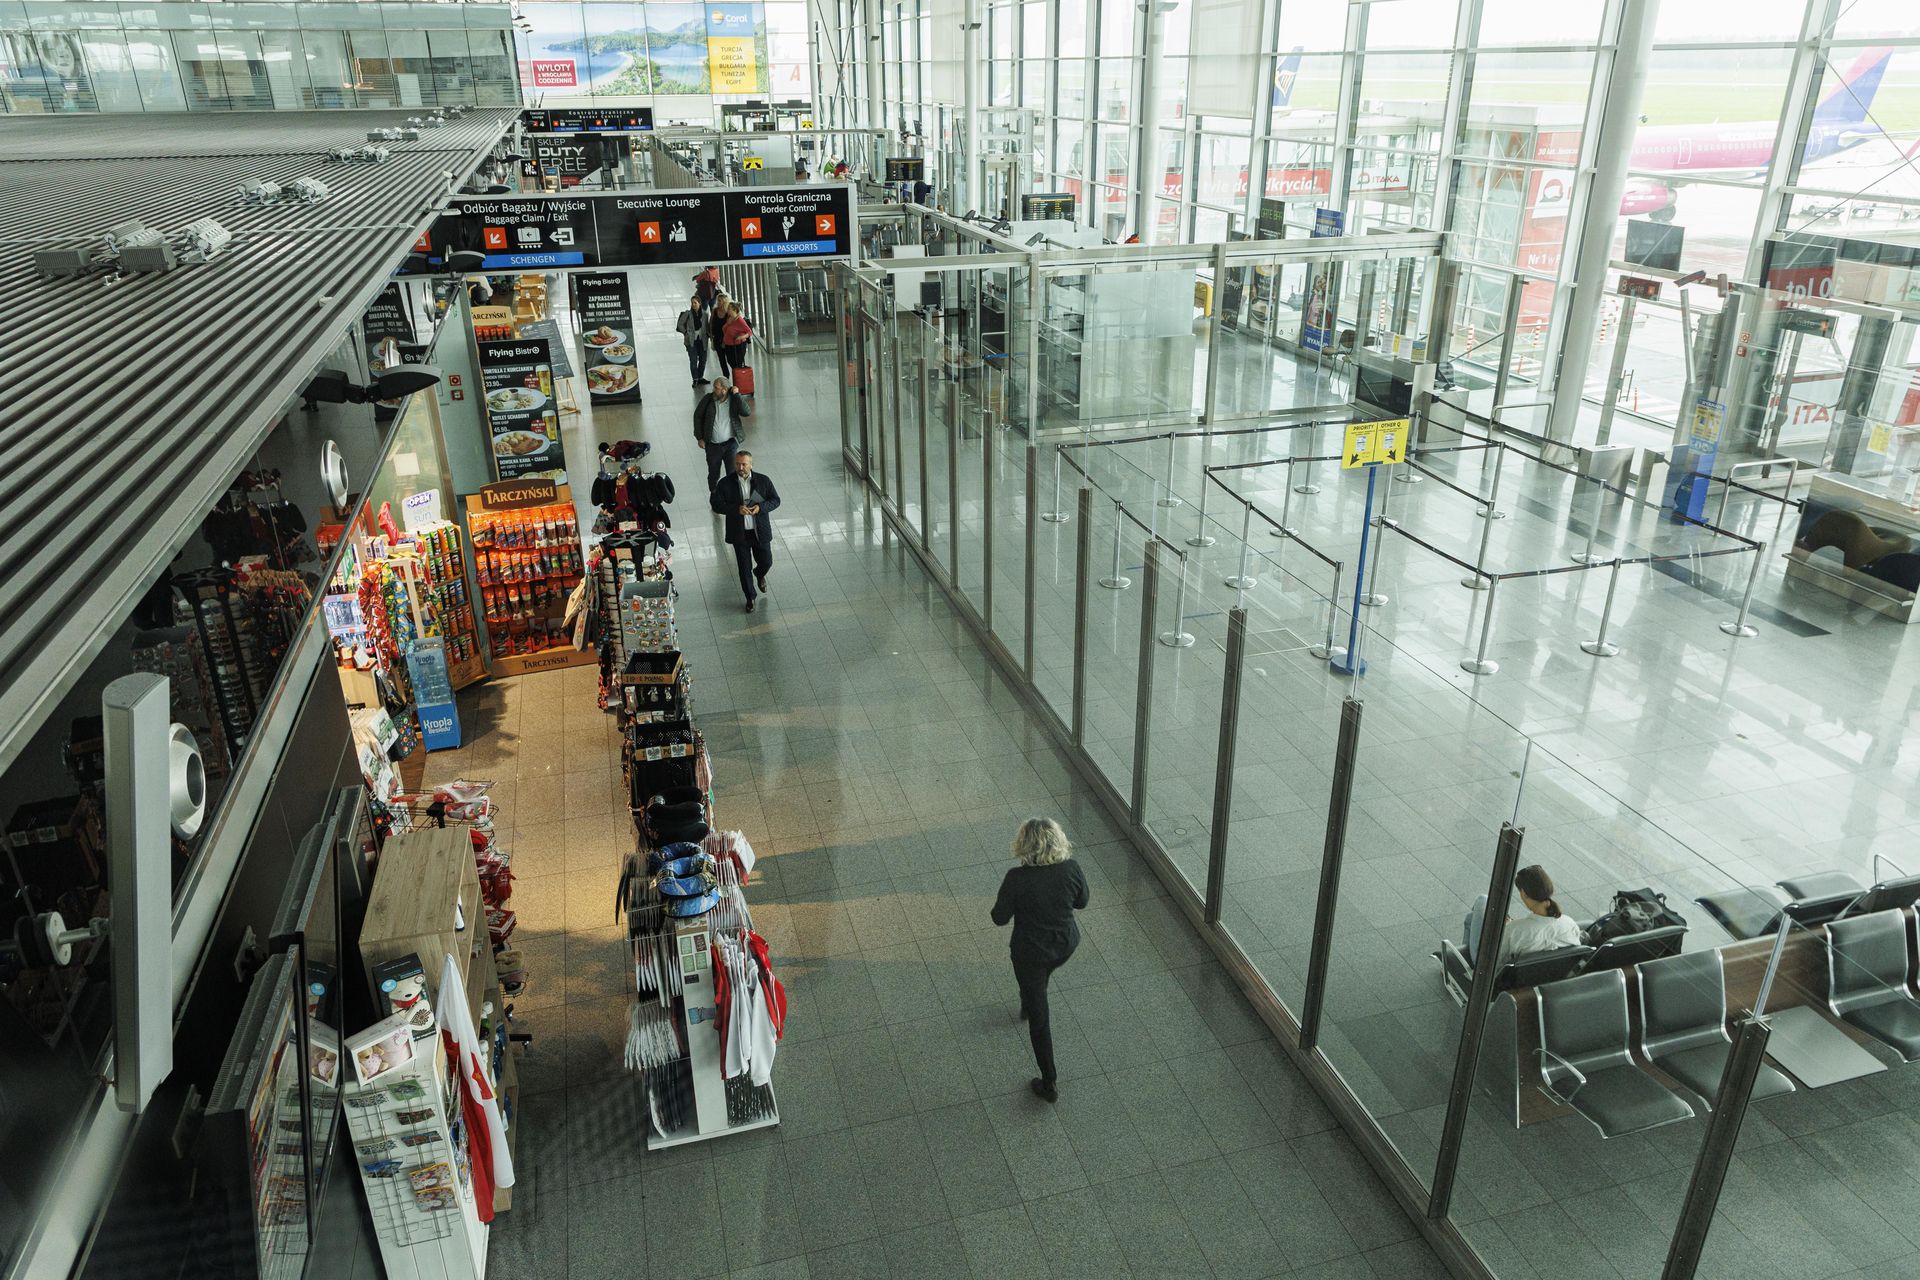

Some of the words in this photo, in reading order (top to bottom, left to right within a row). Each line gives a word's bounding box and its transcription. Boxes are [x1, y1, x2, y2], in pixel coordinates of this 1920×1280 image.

[725, 13, 748, 24] Coral
[536, 63, 571, 72] WYLOTY
[537, 138, 566, 146] SKLEP
[538, 146, 585, 156] DUTY
[540, 157, 588, 172] FREE
[1265, 175, 1318, 194] dkrycia!
[1371, 175, 1400, 184] ITAKA
[617, 197, 664, 209] Executive
[665, 197, 701, 209] Lounge
[744, 193, 784, 205] Kontrola
[786, 191, 832, 203] Graniczna
[463, 202, 499, 215] Odbiór
[502, 201, 538, 214] Bagażu
[548, 199, 586, 213] Wyjście
[761, 204, 787, 214] Border
[787, 203, 817, 213] Control
[484, 213, 520, 225] Baggage
[521, 213, 546, 223] Claim
[553, 212, 569, 222] Exit
[762, 244, 778, 253] ALL
[778, 243, 818, 252] PASSPORTS
[511, 255, 556, 265] SCHENGEN
[1528, 254, 1539, 265] Nr
[1541, 253, 1547, 264] 1
[583, 279, 602, 287] Flying
[602, 277, 621, 285] Bistro
[1621, 279, 1628, 292] 8
[588, 294, 620, 302] ZAPRASZAMY
[596, 300, 622, 308] ŚNIADANIE
[489, 348, 514, 358] Flying
[515, 346, 540, 356] Bistro
[1792, 402, 1830, 426] ITA
[408, 493, 431, 507] OPEN
[484, 485, 555, 505] TARCZYŃSKI
[522, 654, 569, 670] TARCZYŃSKI
[423, 716, 453, 730] Kropla
